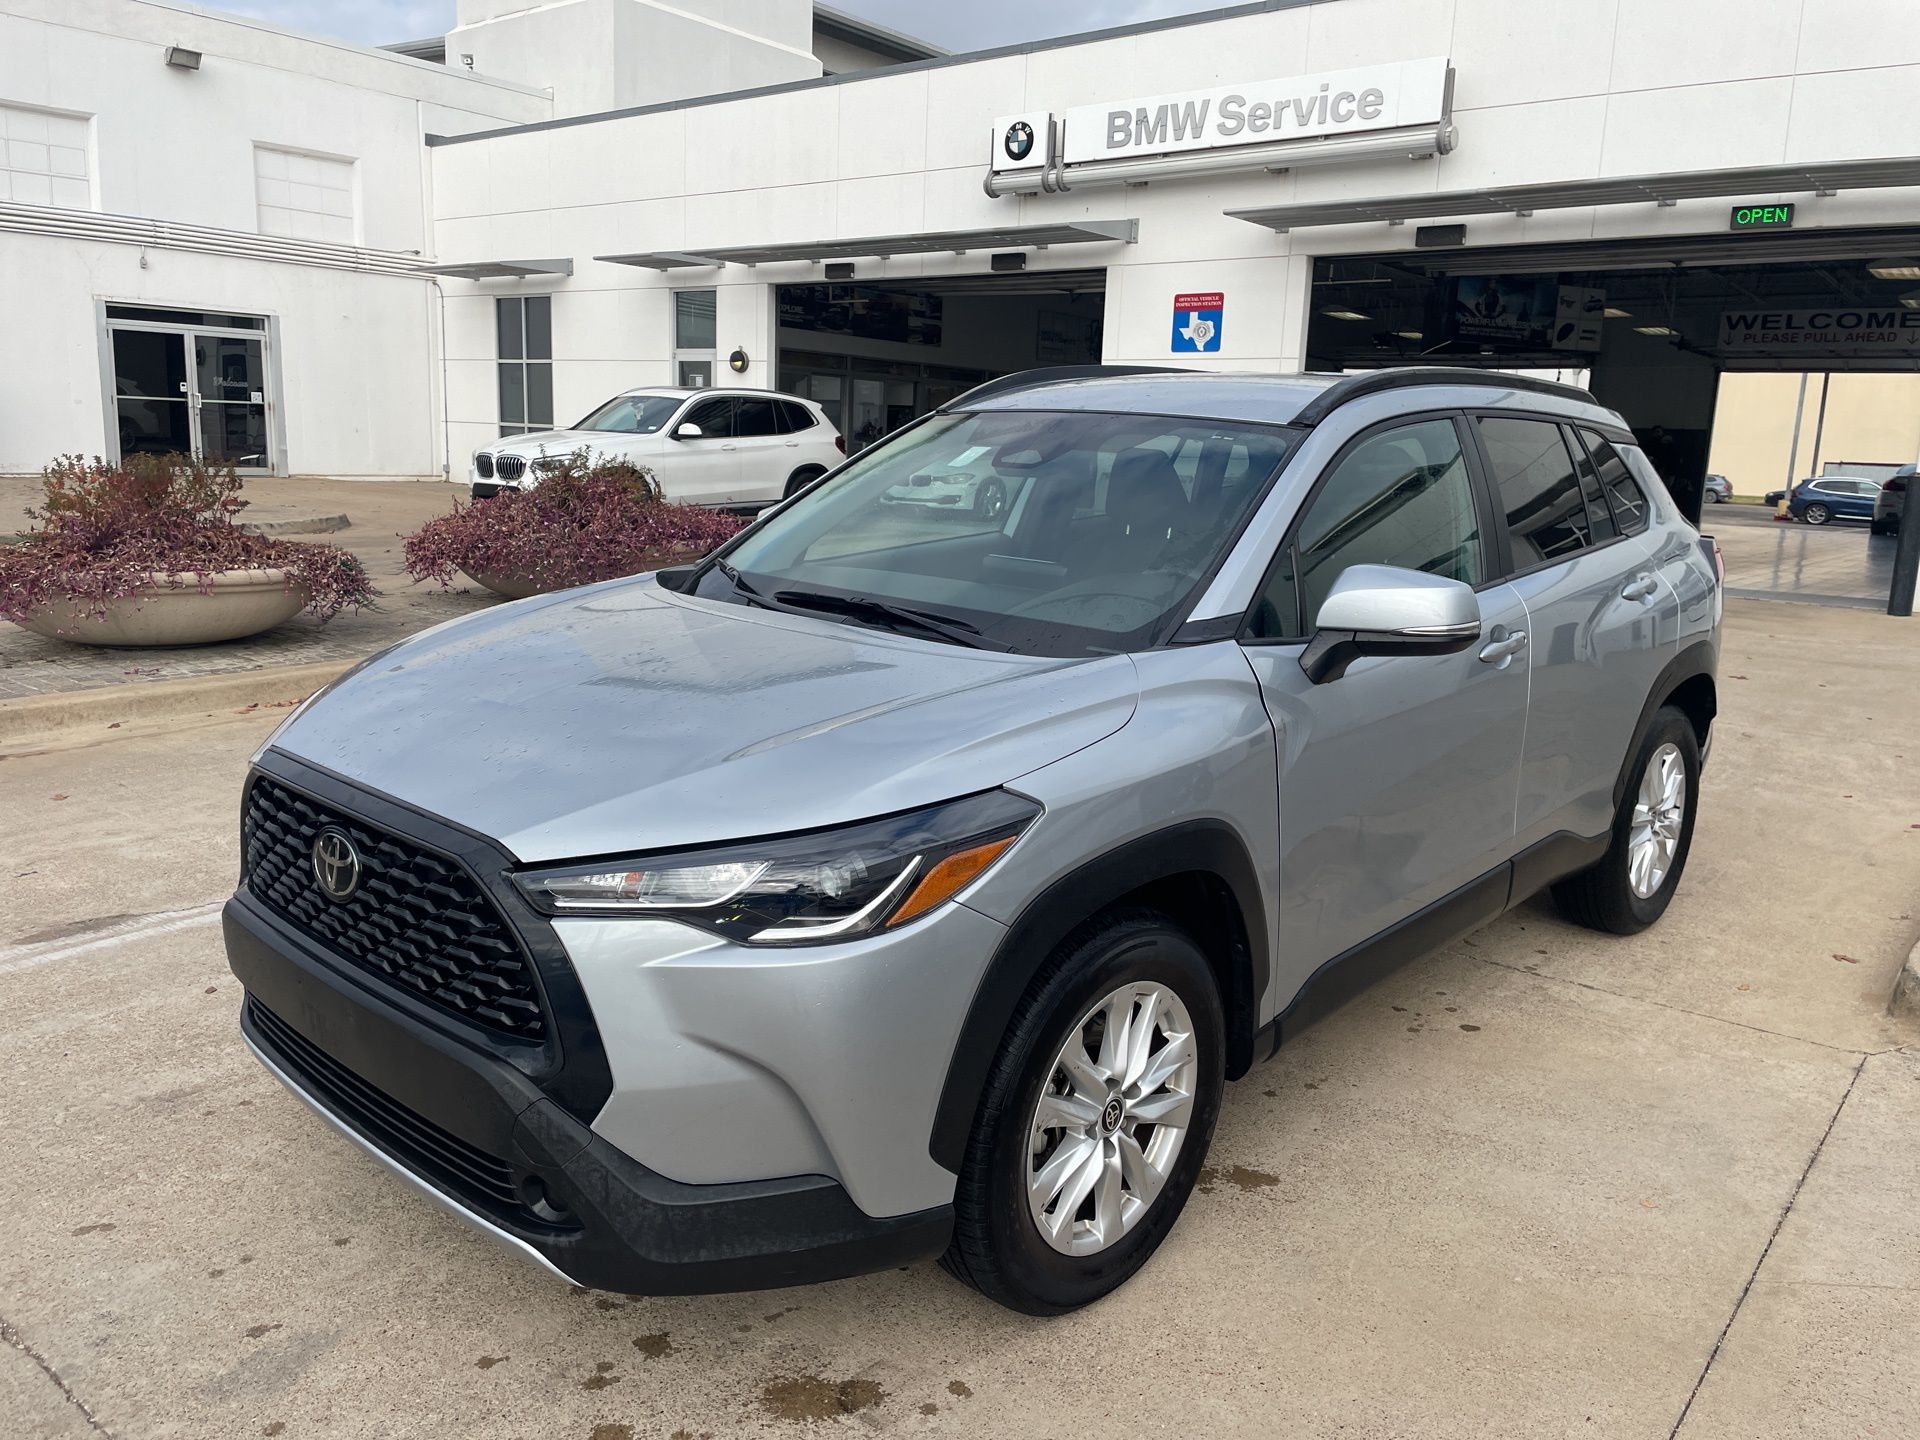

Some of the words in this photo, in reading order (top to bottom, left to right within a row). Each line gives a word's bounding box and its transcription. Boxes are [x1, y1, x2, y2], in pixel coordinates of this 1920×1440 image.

[1106, 98, 1210, 150] BMW
[1216, 82, 1385, 136] Service
[1007, 122, 1032, 137] BMW
[1736, 207, 1788, 224] OPEN
[1726, 313, 1920, 330] WELCOME
[1743, 332, 1799, 343] PLEASE
[1803, 332, 1841, 343] PULL
[1844, 332, 1898, 342] AHEAD
